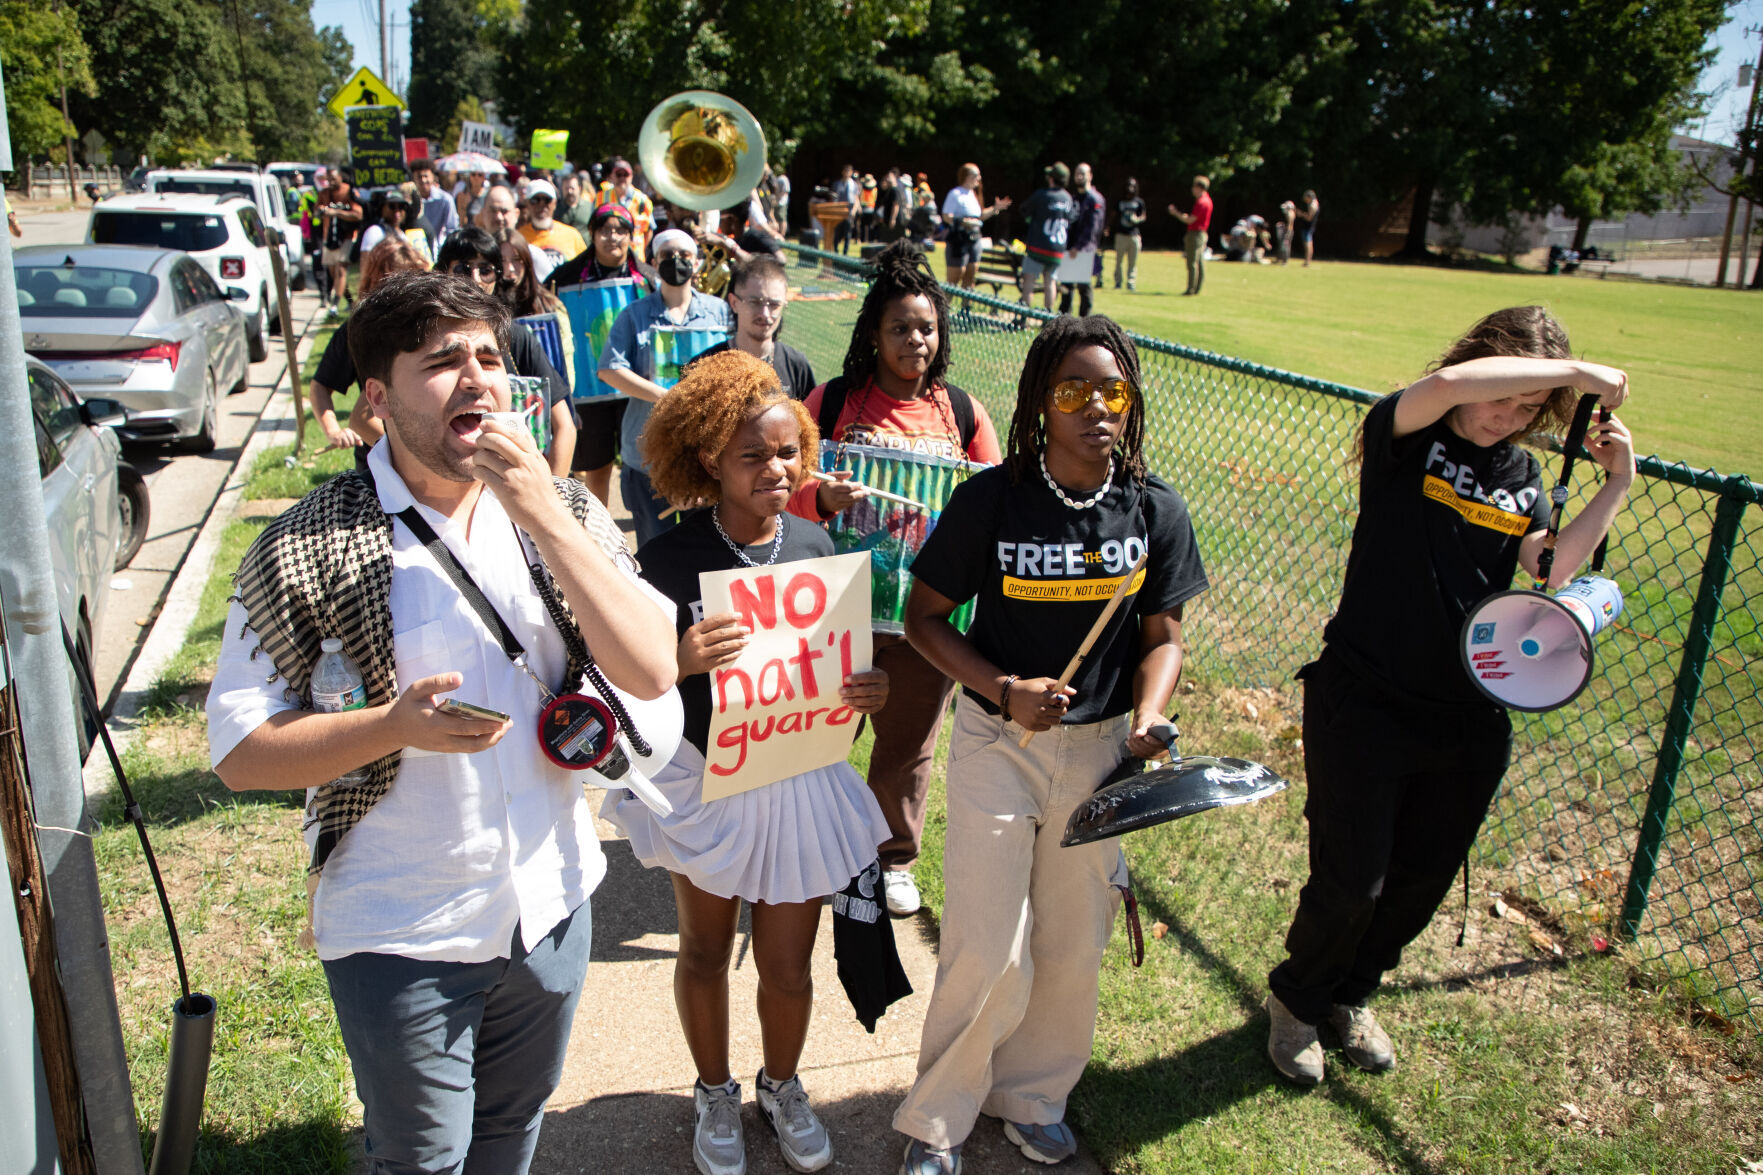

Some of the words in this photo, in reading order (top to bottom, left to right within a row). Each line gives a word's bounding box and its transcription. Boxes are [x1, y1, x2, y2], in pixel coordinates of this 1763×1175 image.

[463, 127, 469, 145] I
[471, 128, 491, 149] AM
[1476, 510, 1494, 522] NOT
[998, 541, 1085, 576] FREE
[1083, 552, 1102, 564] THE
[1008, 583, 1072, 598] OPPORTUNITY,
[1075, 585, 1093, 596] NOT
[729, 572, 827, 634] NO
